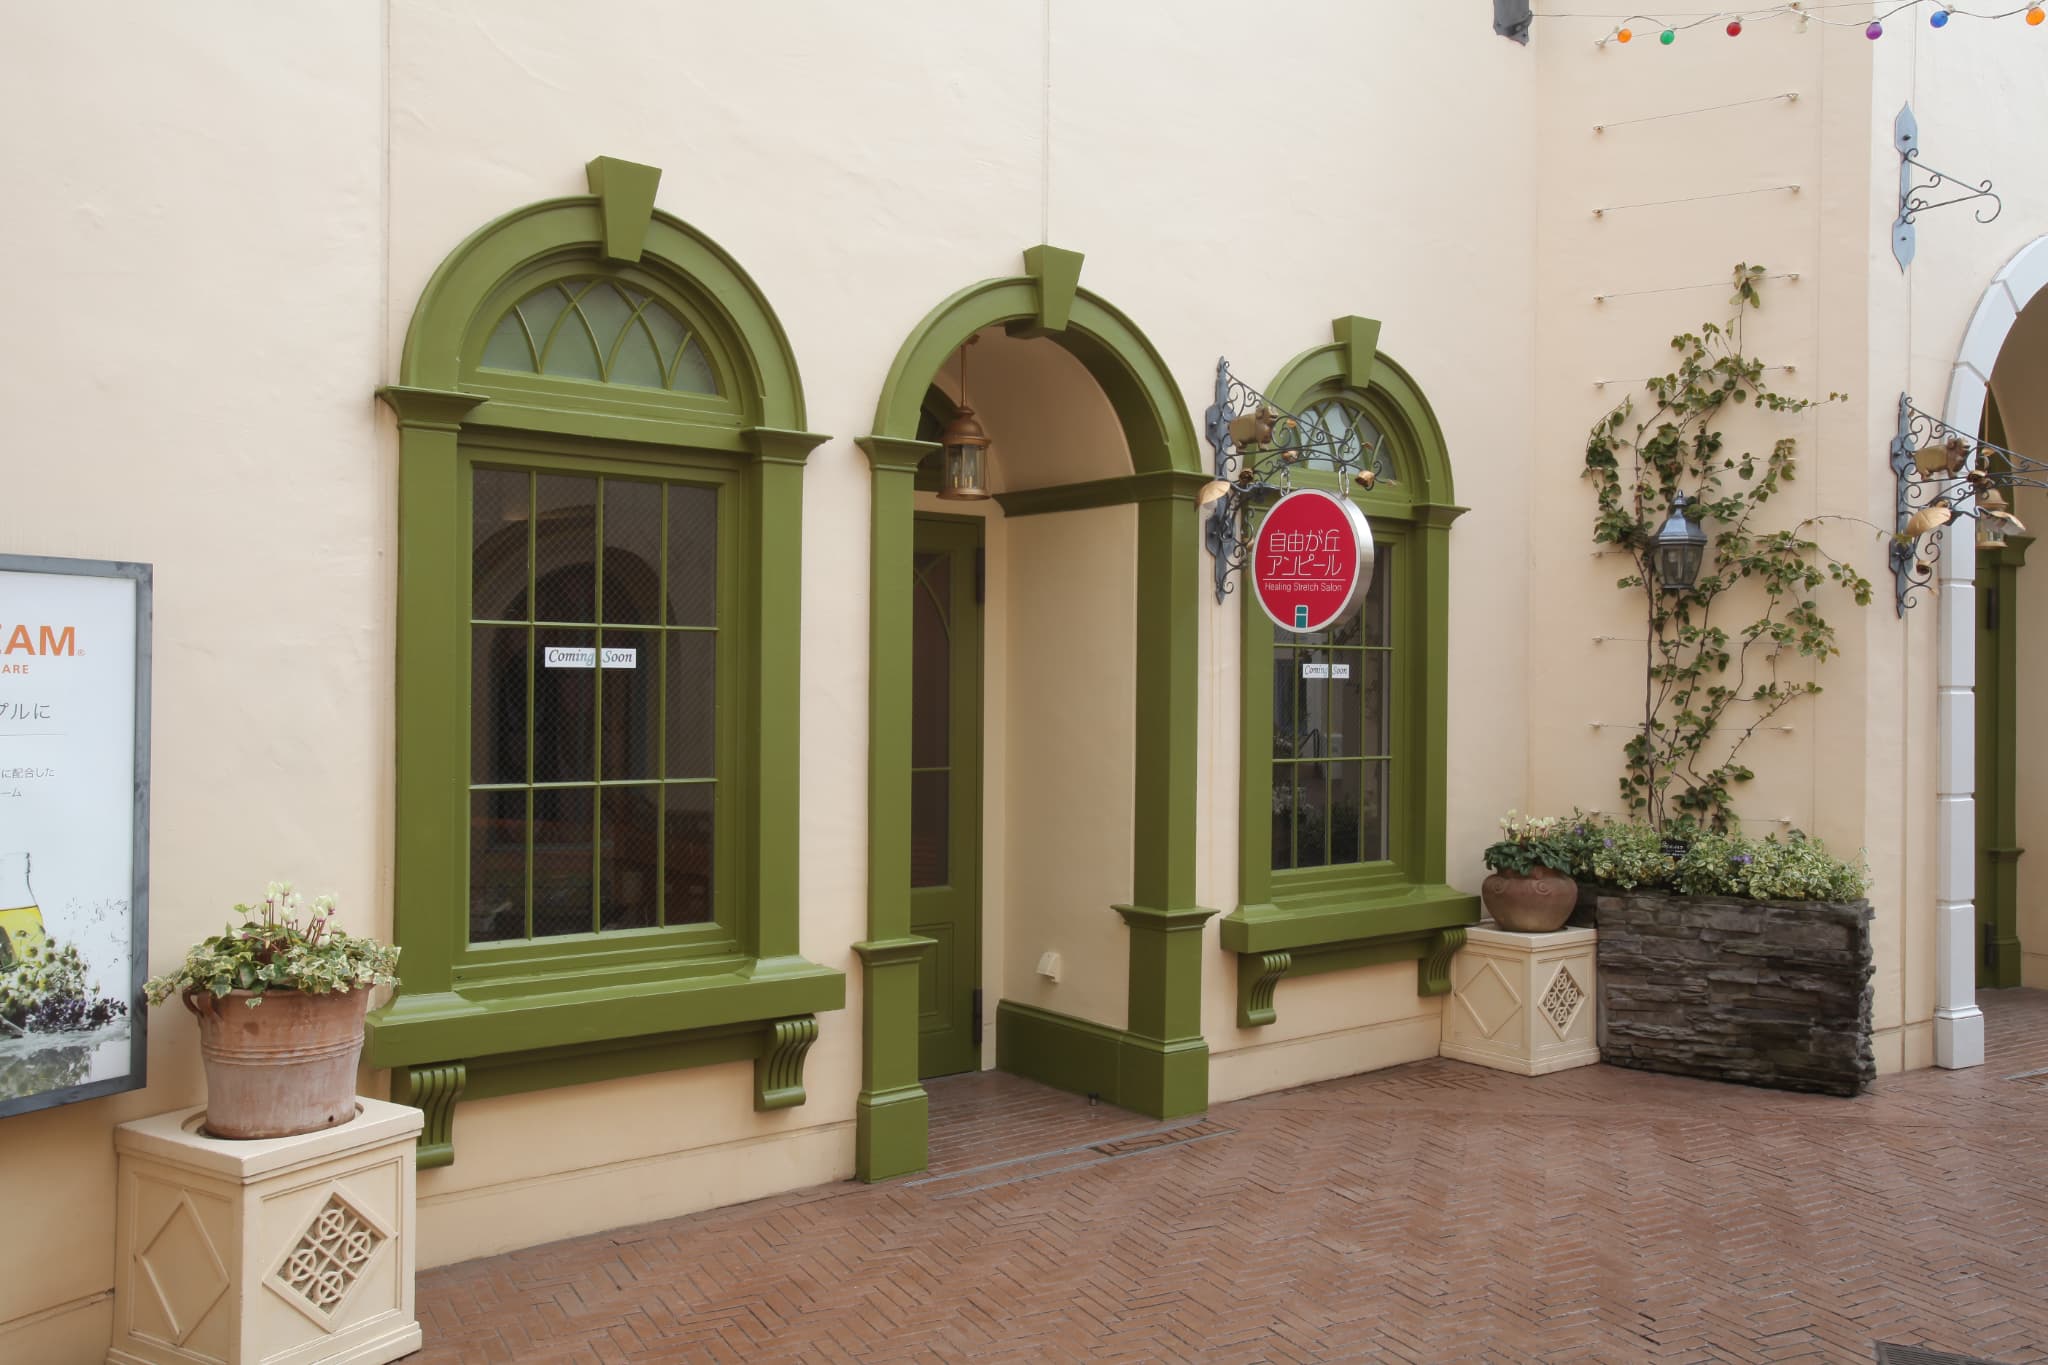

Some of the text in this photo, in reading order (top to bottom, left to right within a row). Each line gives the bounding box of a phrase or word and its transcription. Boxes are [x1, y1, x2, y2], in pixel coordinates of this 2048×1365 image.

[1270, 529, 1341, 552] 自由が丘
[1266, 553, 1342, 576] アンピール
[1265, 582, 1342, 592] Healing Stretch Salon
[0, 624, 75, 656] AM
[548, 648, 633, 666] Coming Soon
[1304, 665, 1348, 677] Coming Soon
